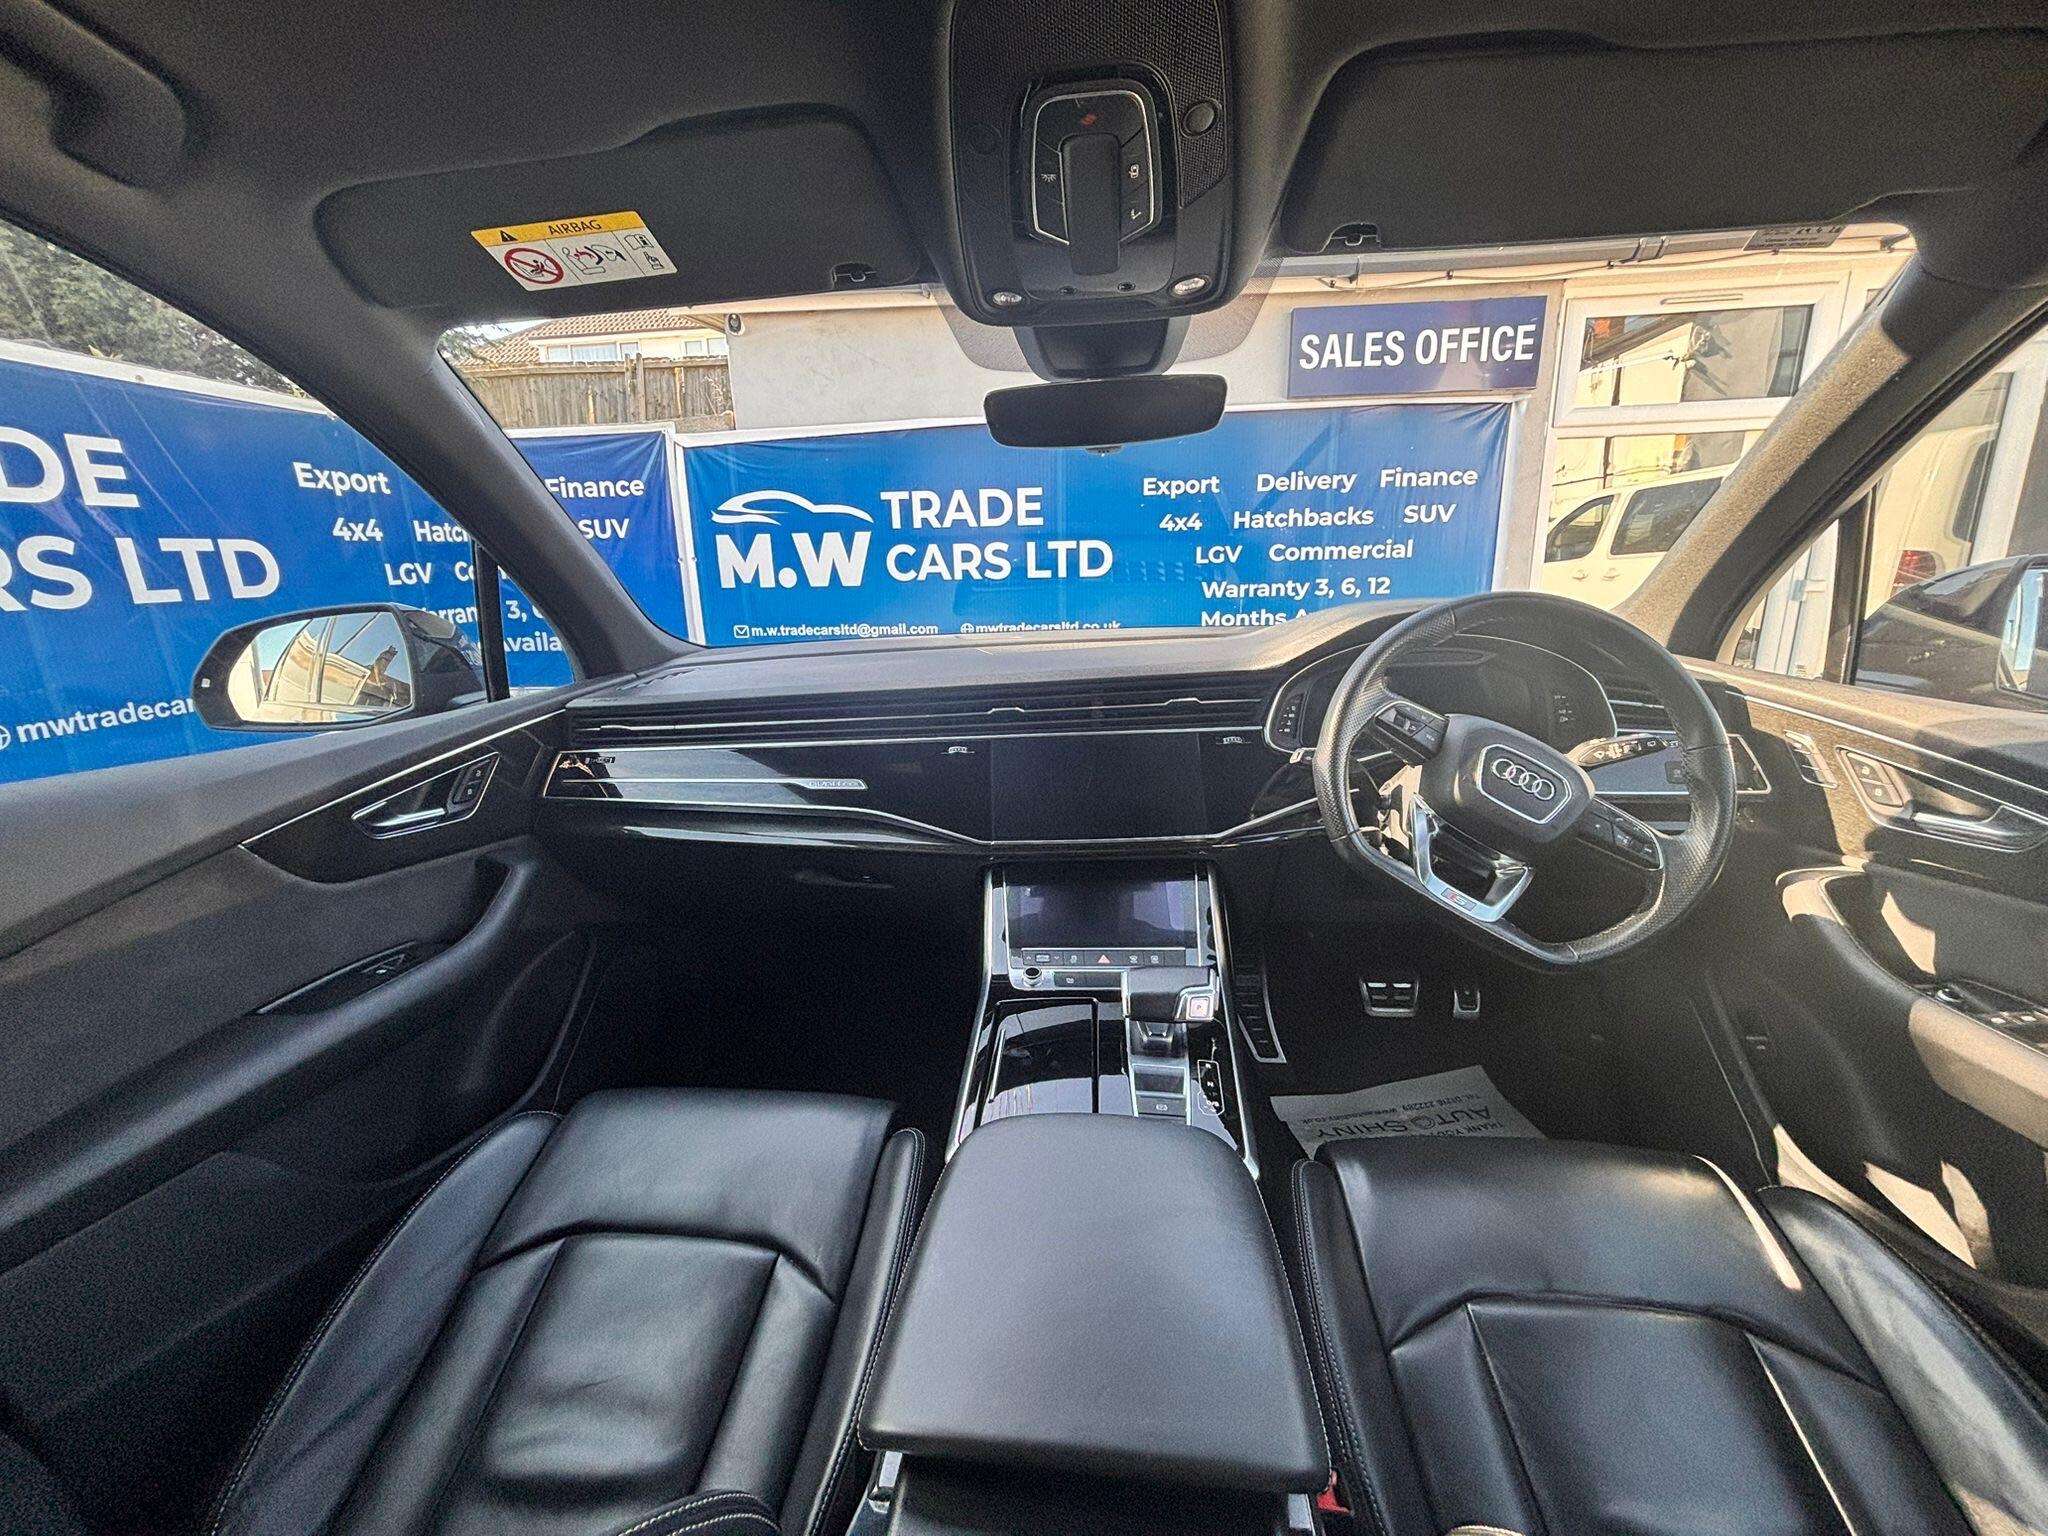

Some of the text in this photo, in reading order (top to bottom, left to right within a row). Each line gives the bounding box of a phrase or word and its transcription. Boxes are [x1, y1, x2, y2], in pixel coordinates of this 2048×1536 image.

[548, 219, 602, 235] AIRBAG
[1299, 323, 1537, 370] SALES OFFICE
[293, 461, 645, 499] Export Finance
[1142, 466, 1479, 498] Export Delivery Finance
[880, 486, 1044, 530] TRADE
[1159, 503, 1457, 533] 4x4 Hatchbacks SUV
[332, 516, 383, 543] 4x4
[578, 517, 630, 540] SUV
[715, 531, 872, 590] M.W
[885, 538, 1114, 582] CARS LTD
[1195, 539, 1414, 565] LGV Commercial
[115, 537, 281, 605] LTD
[384, 562, 433, 586] LGV
[1202, 576, 1391, 602] Warranty 3, 6, 12
[751, 623, 940, 638] m.w.tradecarsltd@gmail.com
[1201, 609, 1287, 628] Months
